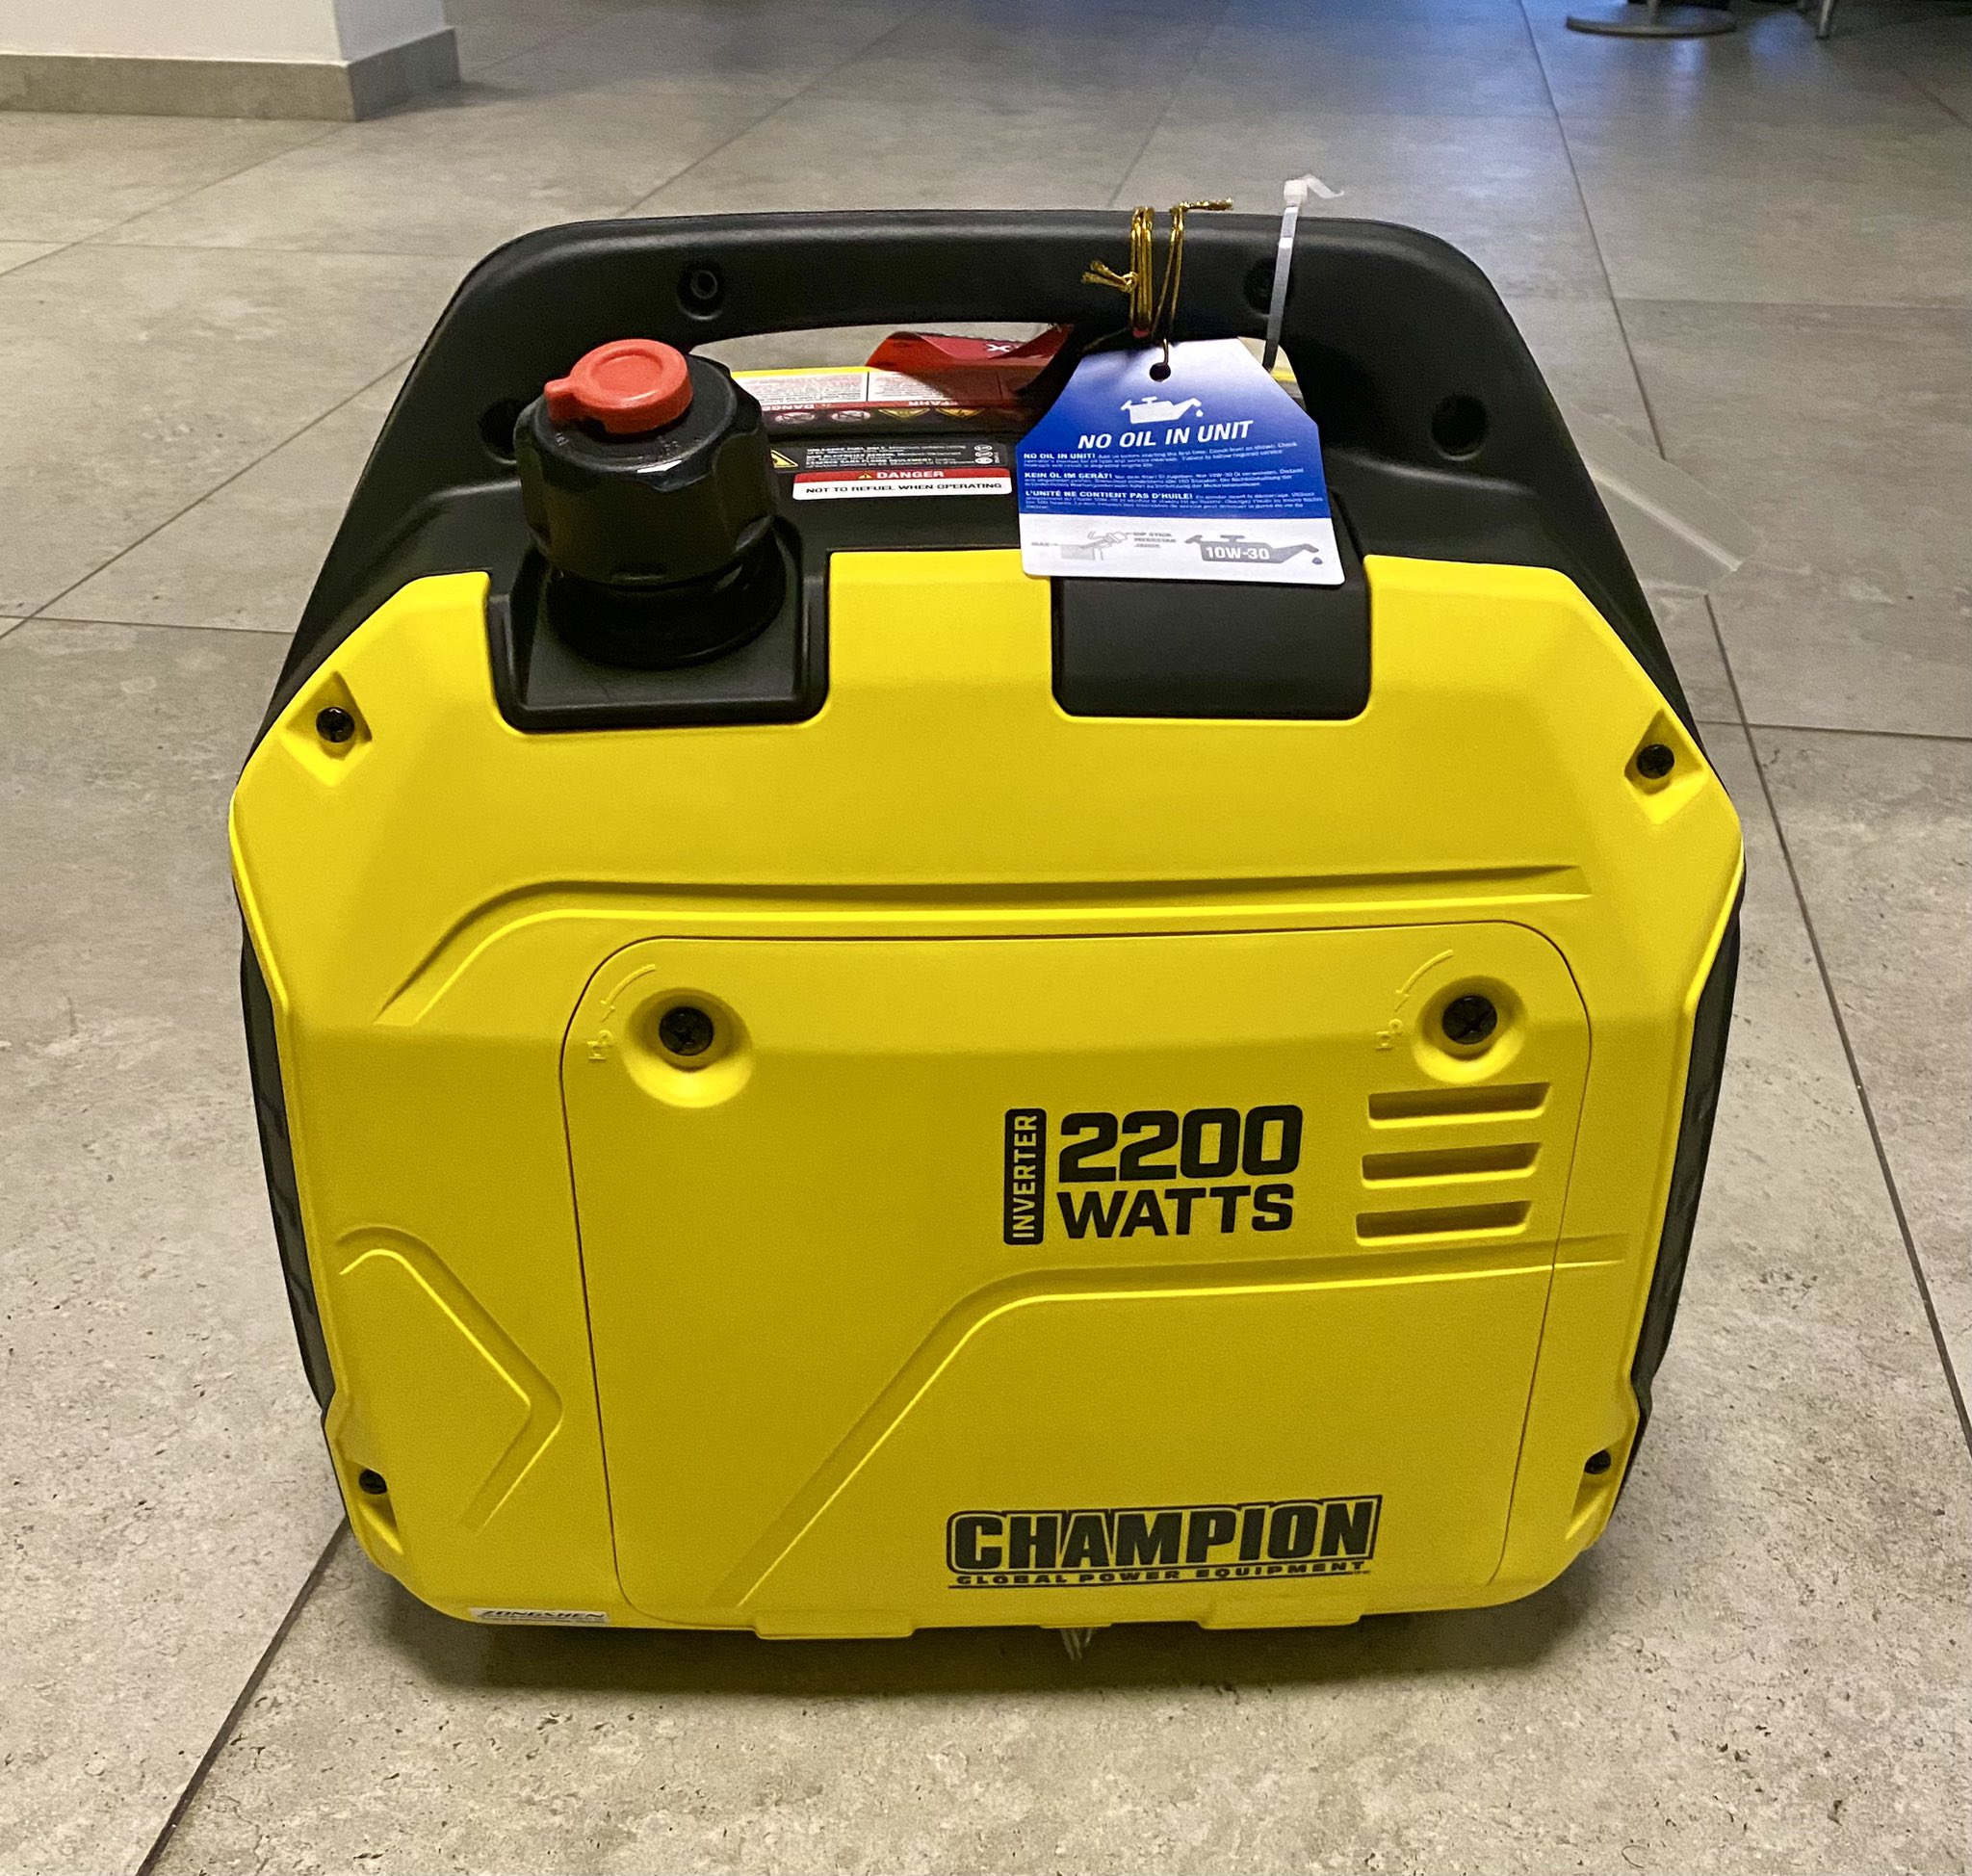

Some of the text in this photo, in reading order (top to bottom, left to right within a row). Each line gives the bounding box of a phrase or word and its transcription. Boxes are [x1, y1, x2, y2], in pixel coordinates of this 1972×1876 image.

[1077, 420, 1254, 449] NO OIL IN UNIT
[876, 470, 945, 480] DANGER
[1206, 546, 1270, 560] 10W-30
[1058, 1105, 1303, 1183] 2200
[1011, 1114, 1038, 1238] INVERTER
[1056, 1184, 1293, 1238] WATTS
[953, 1499, 1377, 1571] CHAMPION
[956, 1574, 1068, 1585] GLOBAL
[1078, 1570, 1181, 1583] POWER
[1196, 1561, 1364, 1578] EQUIPMENT
